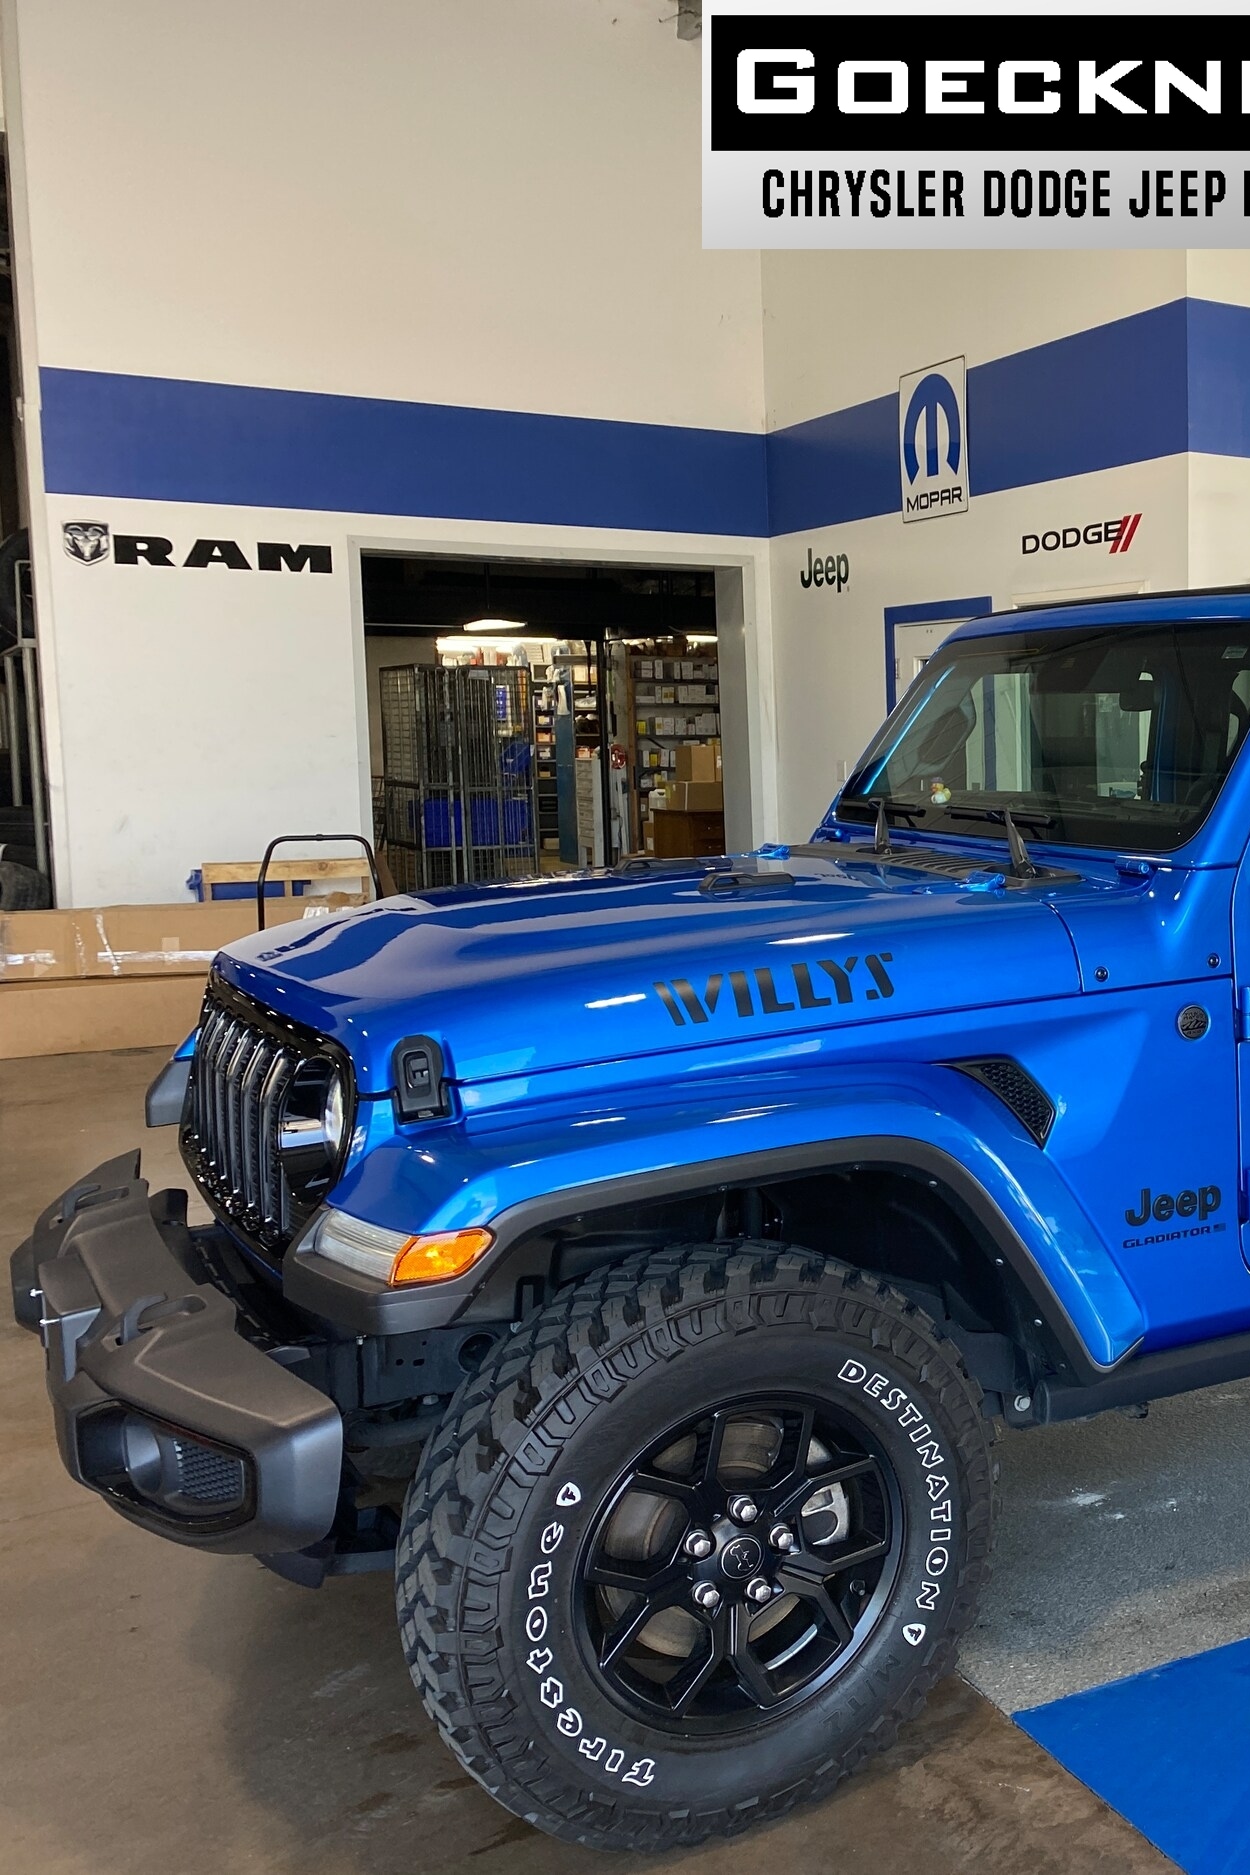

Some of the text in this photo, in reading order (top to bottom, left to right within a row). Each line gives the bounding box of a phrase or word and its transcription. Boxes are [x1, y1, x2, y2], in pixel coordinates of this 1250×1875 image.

[906, 486, 963, 513] MOPAR
[112, 534, 333, 574] RAM
[1022, 519, 1124, 555] DODGE
[800, 548, 850, 593] Jeep
[653, 952, 895, 1027] WILLYS
[1124, 1184, 1222, 1228] Jeep
[1122, 1225, 1211, 1249] GLADIATOR
[837, 1358, 952, 1611] DESTINATION
[525, 1521, 656, 1787] Firestone
